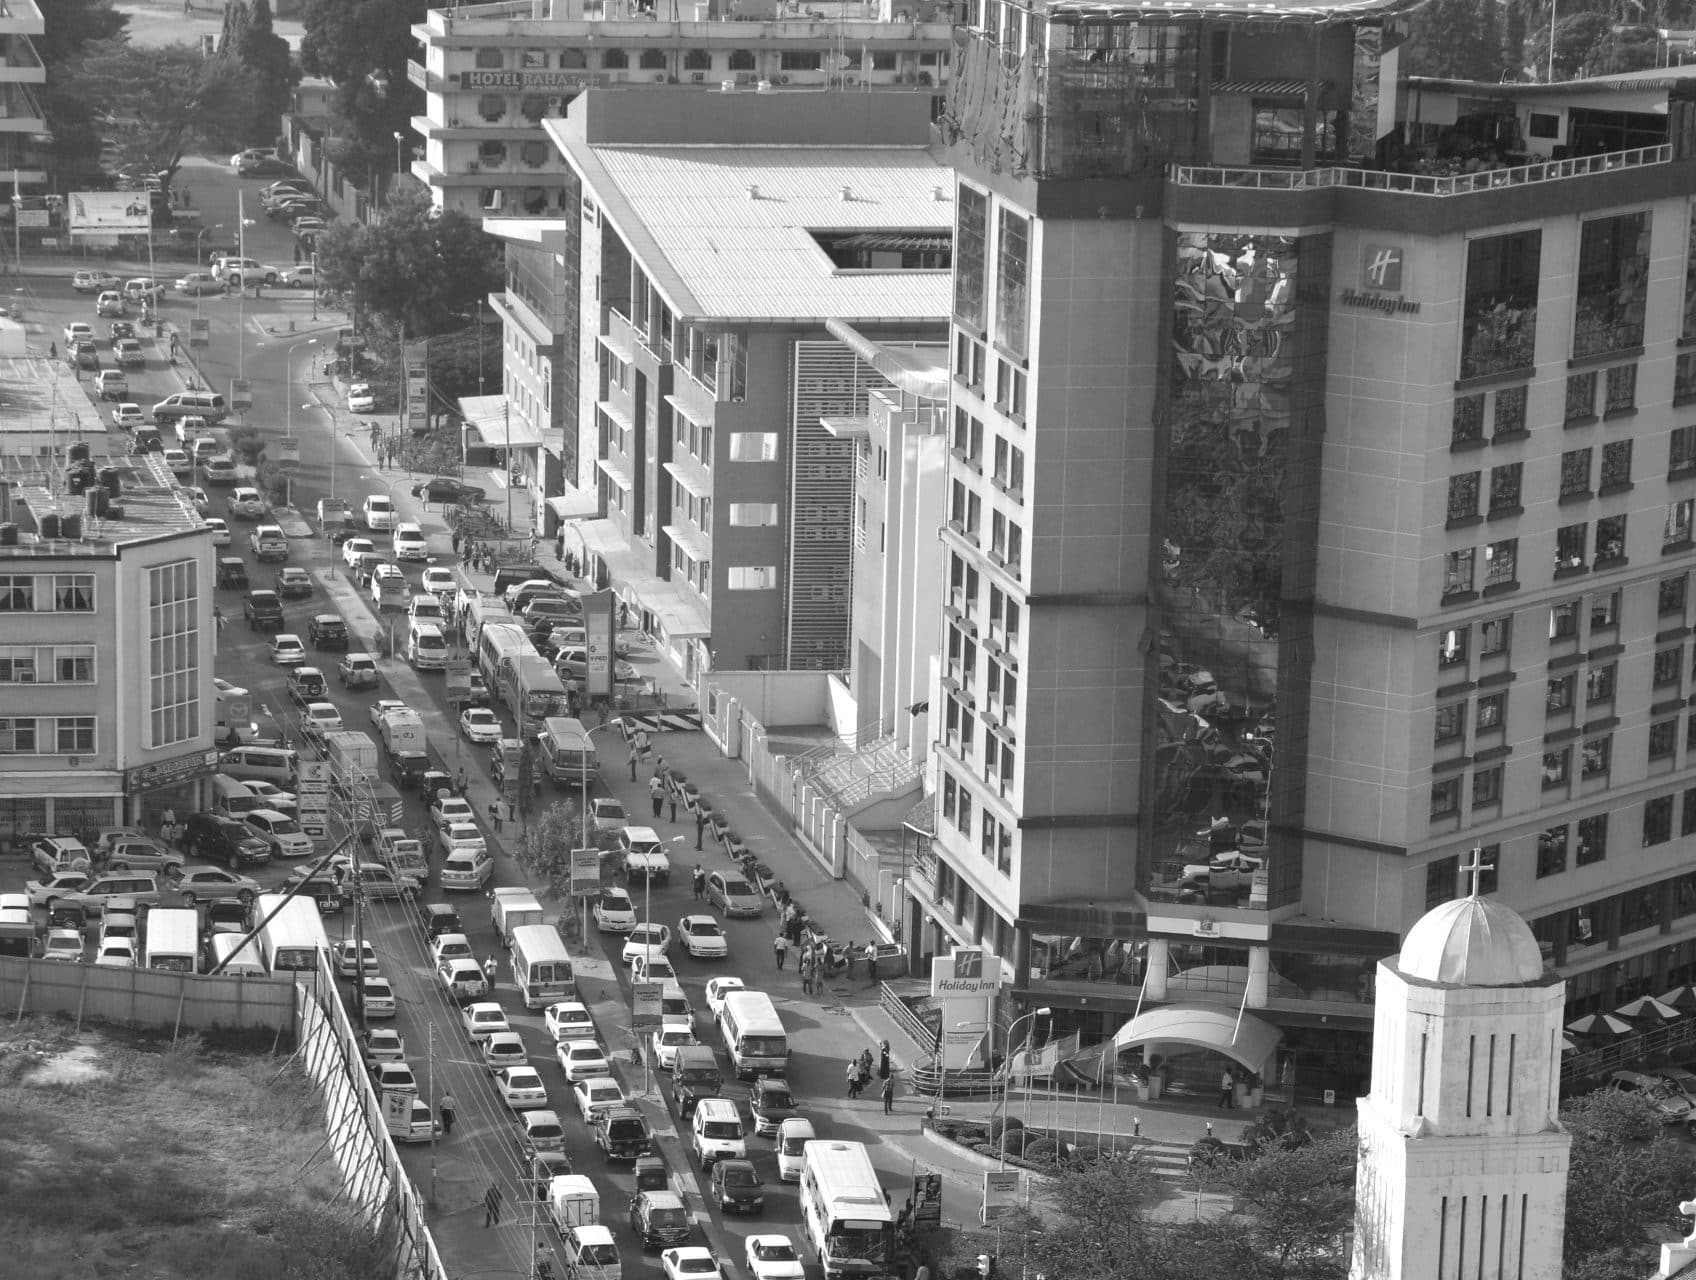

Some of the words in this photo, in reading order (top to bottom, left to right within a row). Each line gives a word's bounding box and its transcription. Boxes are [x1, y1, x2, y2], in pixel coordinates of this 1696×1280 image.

[469, 73, 520, 85] HOTEL
[523, 73, 567, 85] RAHA
[1341, 287, 1396, 315] Holiday
[1397, 295, 1421, 314] Inn
[939, 979, 979, 992] Holiday
[979, 980, 995, 990] Inn
